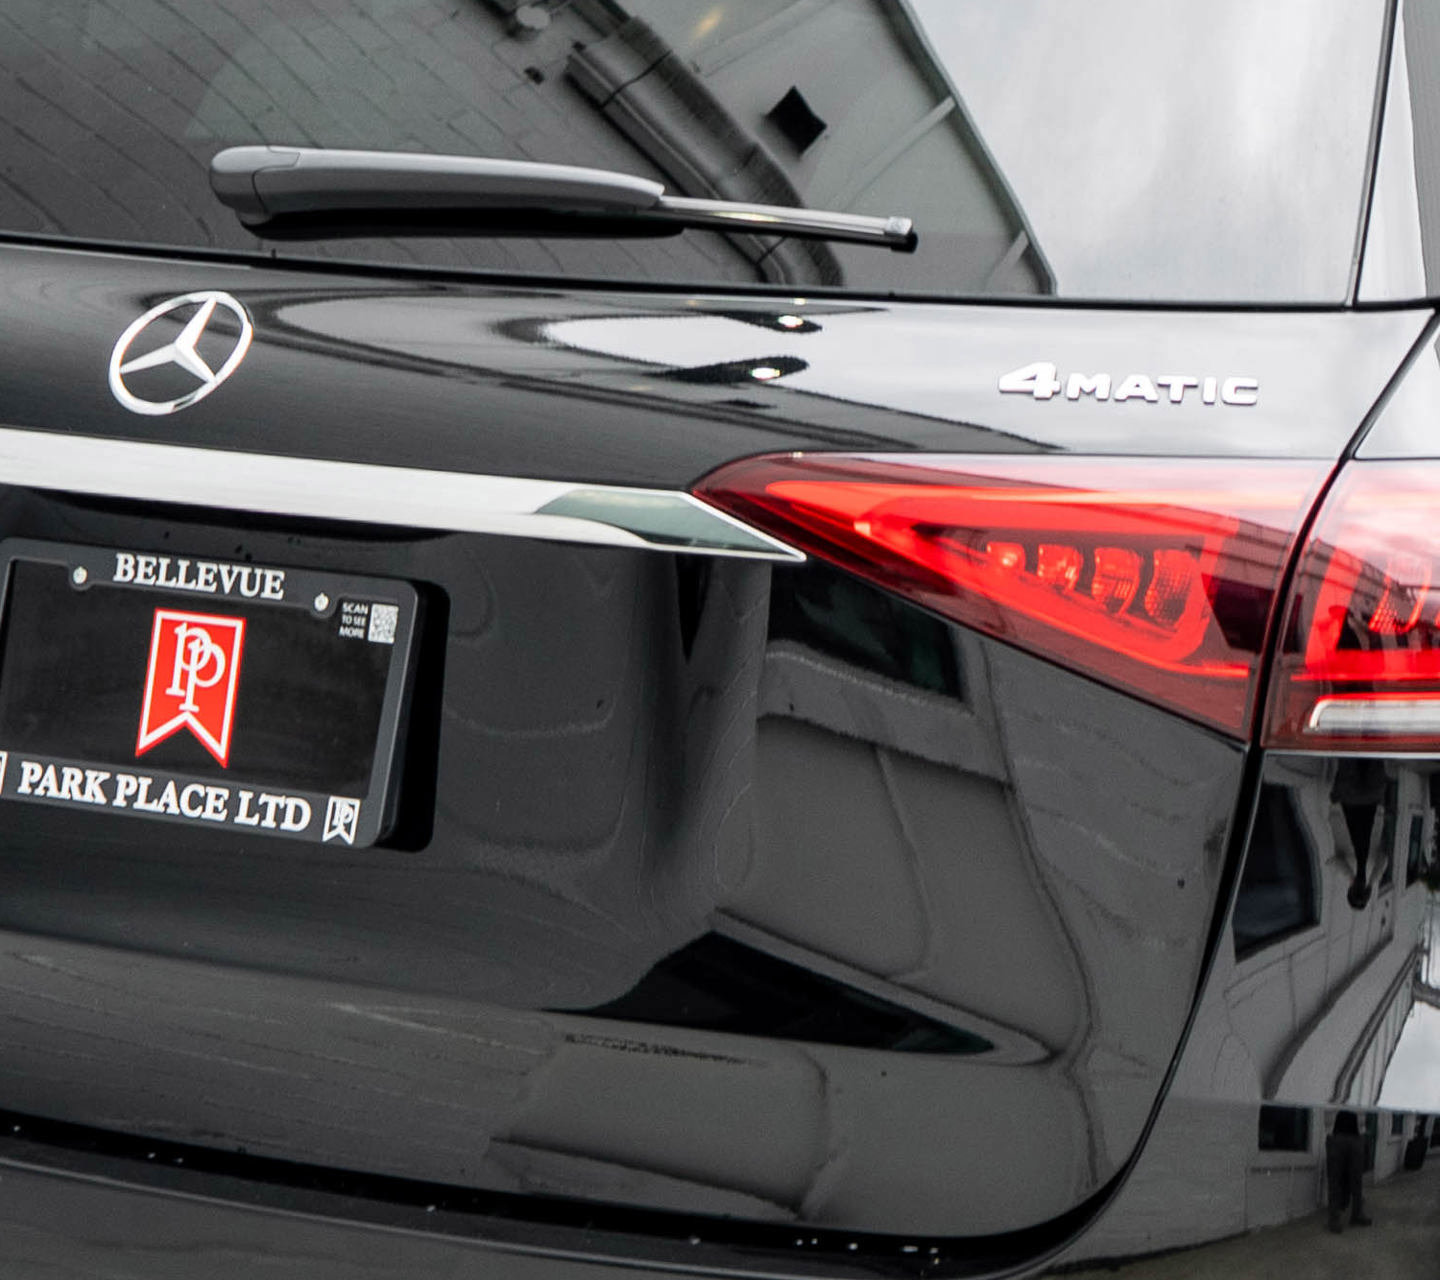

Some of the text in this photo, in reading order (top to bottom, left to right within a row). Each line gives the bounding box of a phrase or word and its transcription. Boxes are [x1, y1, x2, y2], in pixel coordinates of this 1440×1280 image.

[998, 361, 1259, 406] 4MATIC
[112, 552, 286, 600] BELLEVUE
[341, 614, 353, 625] TO
[342, 602, 369, 615] SCAN
[339, 625, 365, 639] MORE
[16, 761, 312, 833] PARK PLACE LTD
